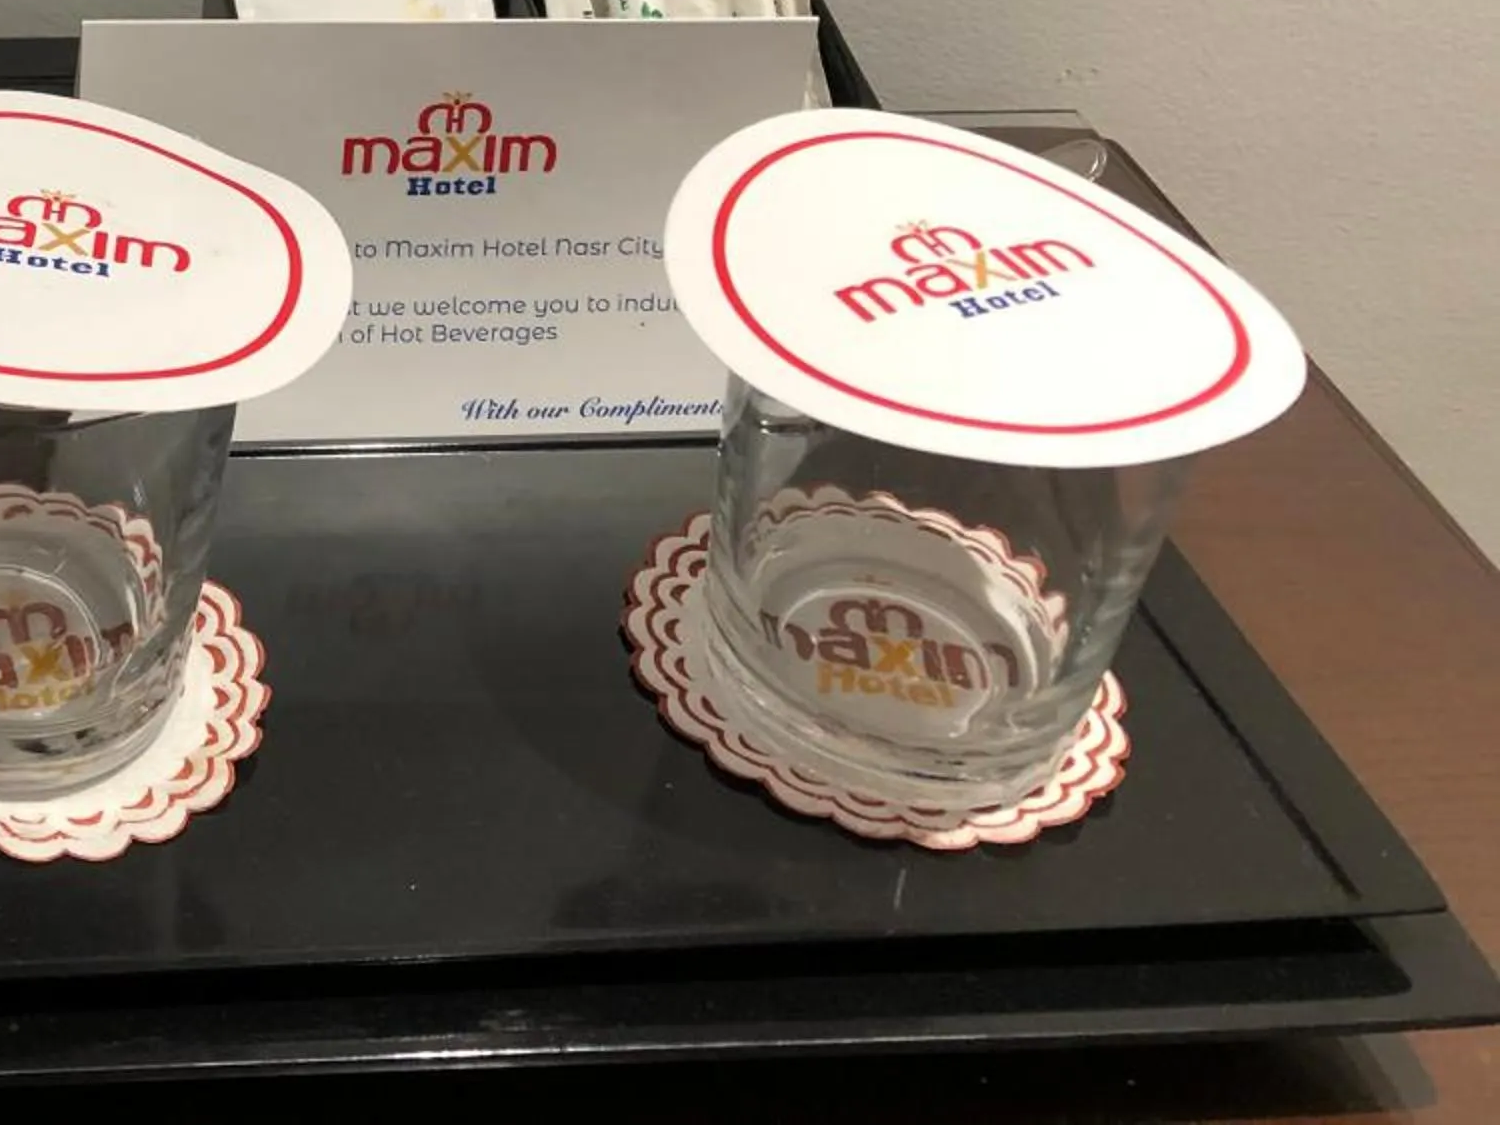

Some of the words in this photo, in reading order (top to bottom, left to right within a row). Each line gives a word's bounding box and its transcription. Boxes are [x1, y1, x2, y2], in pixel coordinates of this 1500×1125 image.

[341, 134, 557, 175] maxim
[406, 176, 496, 196] Hotel
[354, 242, 377, 259] to
[385, 239, 475, 259] Maxim
[482, 237, 548, 257] Hotel
[555, 237, 611, 256] Nasr
[617, 236, 664, 260] City
[834, 240, 1094, 322] maxim
[368, 301, 405, 316] we
[413, 296, 527, 316] welcome
[534, 298, 579, 318] you
[587, 296, 610, 313] to
[949, 280, 1061, 319] Hotel
[350, 324, 375, 344] of
[380, 325, 423, 344] Hot
[431, 322, 558, 346] Beverages
[461, 398, 519, 420] With
[526, 406, 569, 419] our
[815, 661, 956, 708] Hotel
